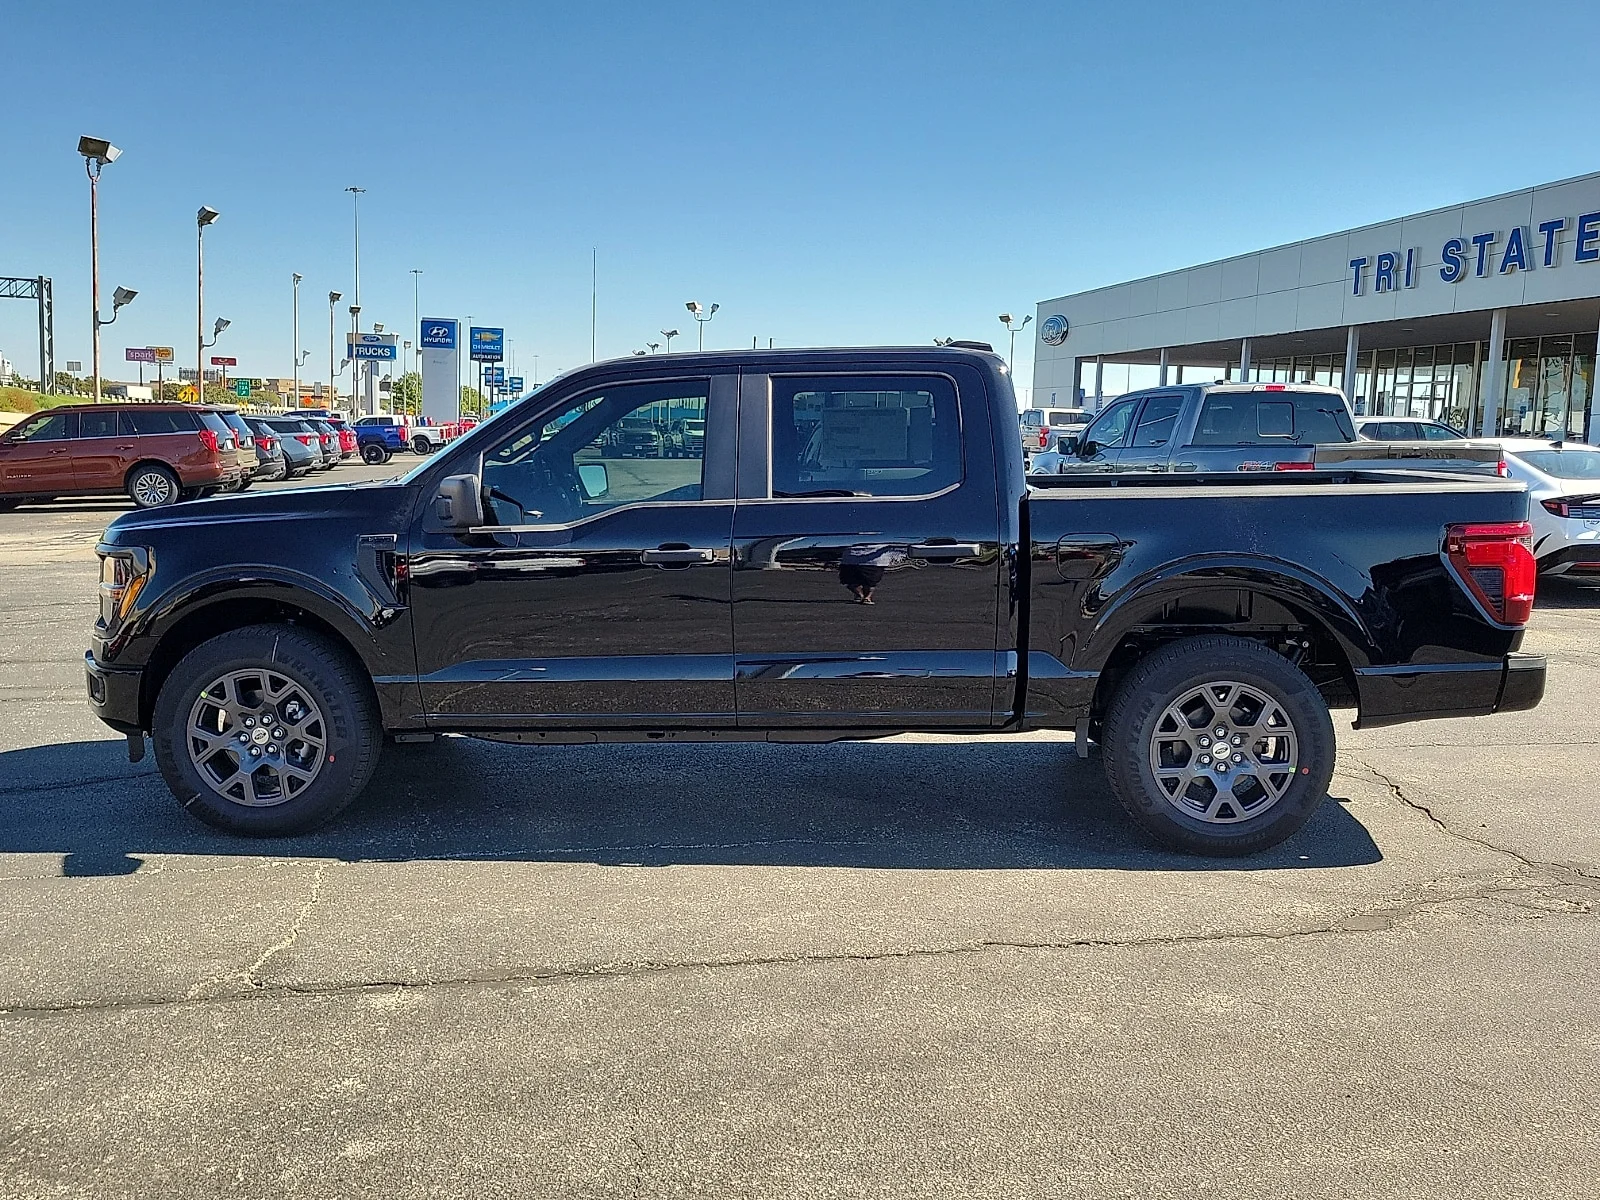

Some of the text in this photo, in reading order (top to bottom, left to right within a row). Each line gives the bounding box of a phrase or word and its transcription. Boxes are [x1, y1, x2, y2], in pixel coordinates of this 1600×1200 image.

[1349, 210, 1600, 296] TRI STATE
[355, 346, 391, 357] TRUCKS
